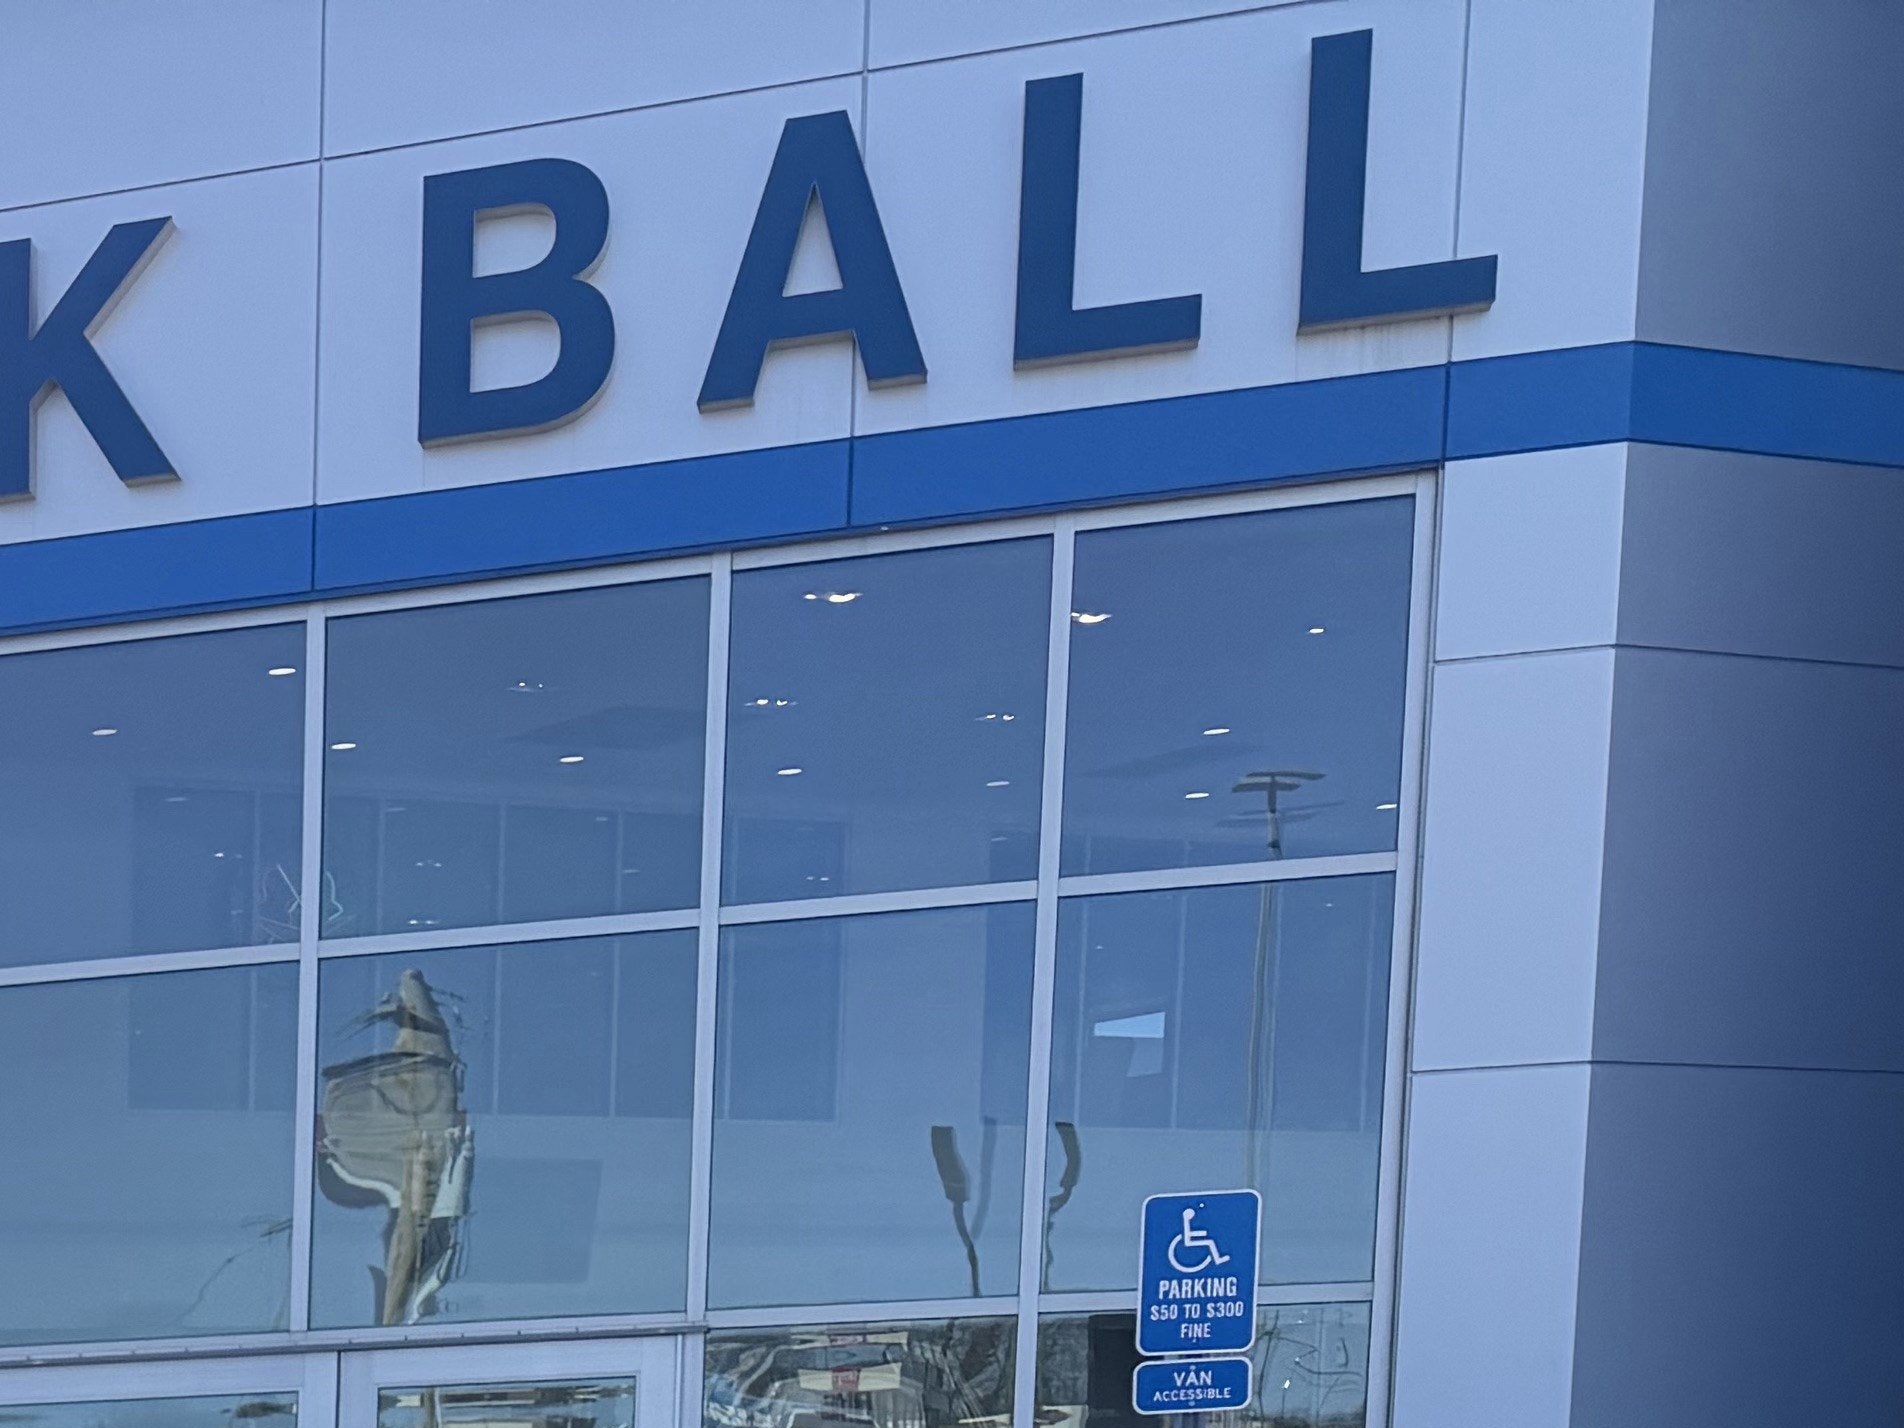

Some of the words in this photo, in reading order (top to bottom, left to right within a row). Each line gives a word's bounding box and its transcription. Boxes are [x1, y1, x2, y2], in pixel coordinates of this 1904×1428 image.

[412, 26, 1500, 452] BALL
[1158, 1276, 1238, 1300] PARKING
[1184, 1303, 1200, 1319] TO
[1180, 1322, 1211, 1339] FINE
[1173, 1370, 1212, 1387] VAN
[1153, 1387, 1232, 1402] ACCESSIBLE
